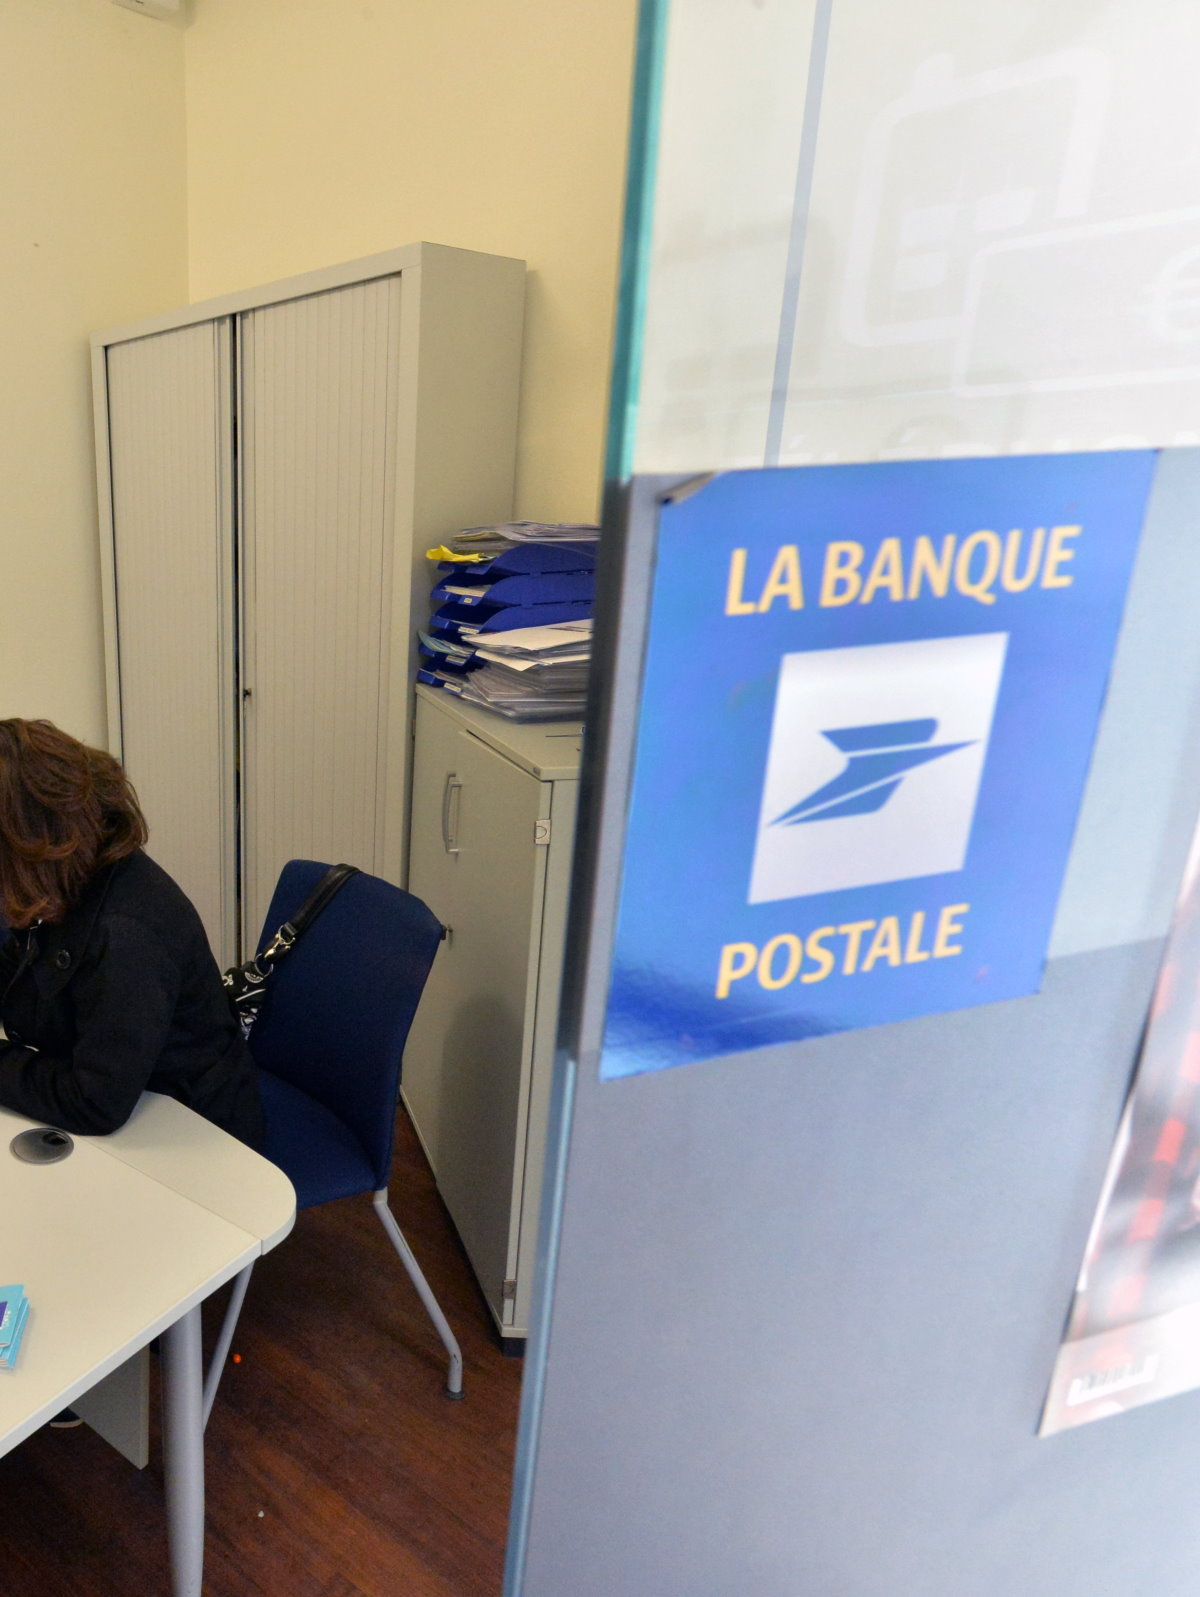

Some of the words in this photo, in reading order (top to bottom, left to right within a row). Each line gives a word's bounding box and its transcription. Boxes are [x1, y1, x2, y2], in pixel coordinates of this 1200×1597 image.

[724, 544, 804, 617] LA
[818, 524, 1083, 606] BANQUE
[714, 903, 970, 1000] POSTALE
